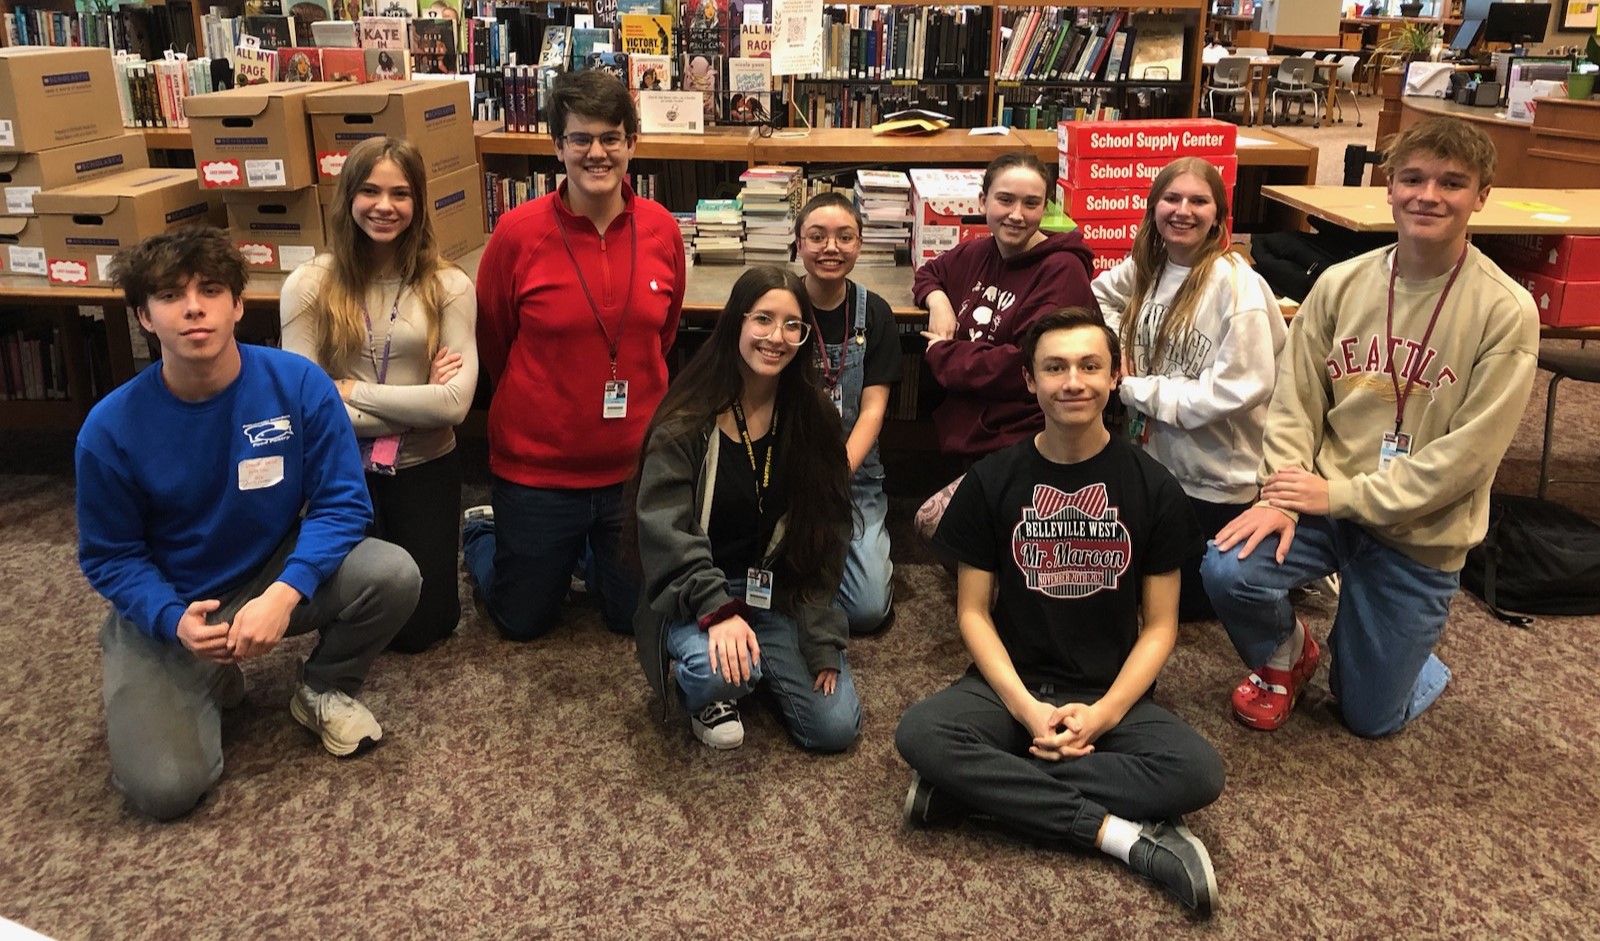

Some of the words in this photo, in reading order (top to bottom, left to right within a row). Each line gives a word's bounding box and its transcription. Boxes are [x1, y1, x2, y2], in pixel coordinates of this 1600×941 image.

[364, 28, 400, 41] KATE
[742, 24, 760, 34] ALL
[764, 24, 772, 34] M
[377, 40, 388, 48] IN
[625, 37, 659, 48] VICTORY.
[236, 47, 253, 60] ALL
[256, 50, 271, 63] MY
[240, 63, 266, 77] RAGE
[1091, 132, 1133, 148] School
[1136, 132, 1180, 151] Supply
[1182, 131, 1224, 147] Center
[1090, 163, 1133, 179] School
[1136, 162, 1162, 181] Sup
[1086, 195, 1129, 211] School
[1083, 224, 1126, 240] School
[1092, 255, 1126, 269] choo
[1025, 520, 1086, 538] BELLEVILLE
[1088, 520, 1118, 538] WEST
[1020, 542, 1053, 569] Mr.
[1053, 542, 1125, 568] Maroon
